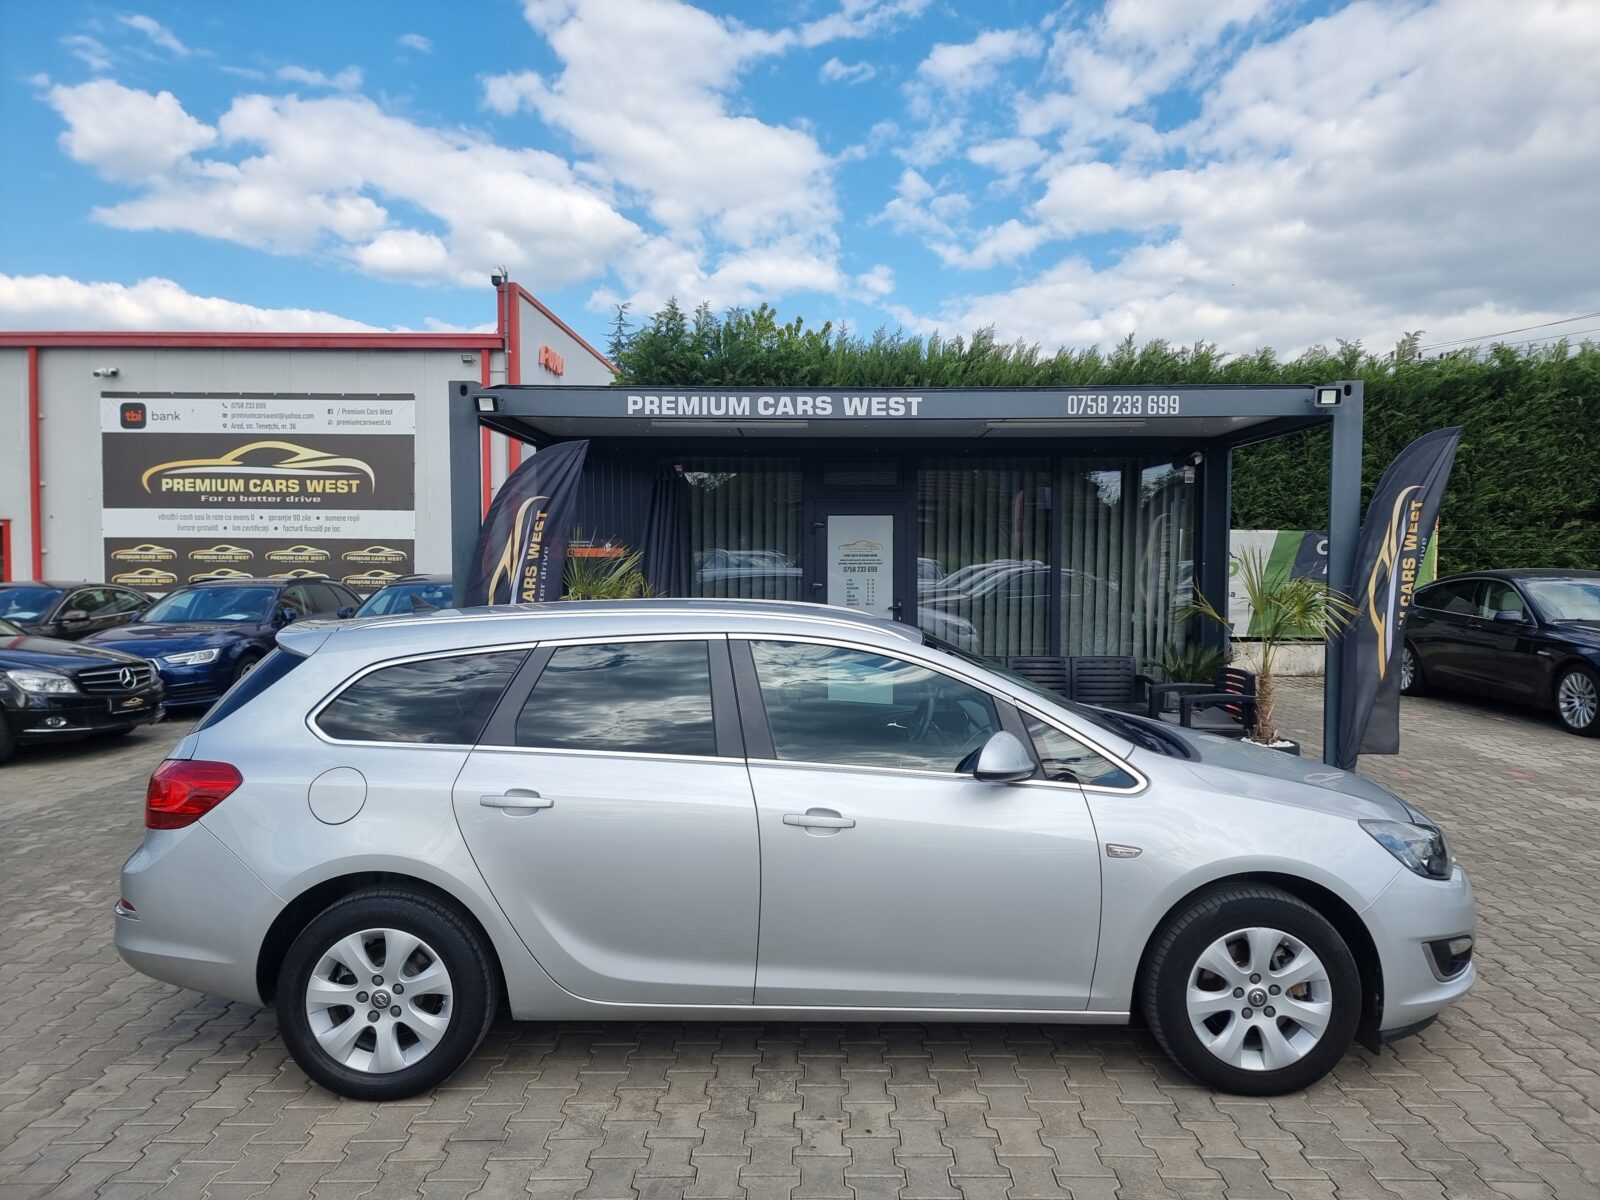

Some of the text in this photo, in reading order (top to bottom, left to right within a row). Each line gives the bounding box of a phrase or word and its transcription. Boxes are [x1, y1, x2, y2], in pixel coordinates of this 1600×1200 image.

[627, 395, 923, 416] PREMIUM CARS WEST
[1067, 395, 1180, 415] 0758 233 699
[124, 410, 143, 421] tbi
[151, 411, 181, 421] bank
[161, 478, 360, 493] PREMIUM CARS WEST
[240, 495, 282, 503] better
[522, 509, 548, 603] ARS WEST
[540, 546, 549, 579] drive
[1400, 500, 1424, 607] CARS WEST
